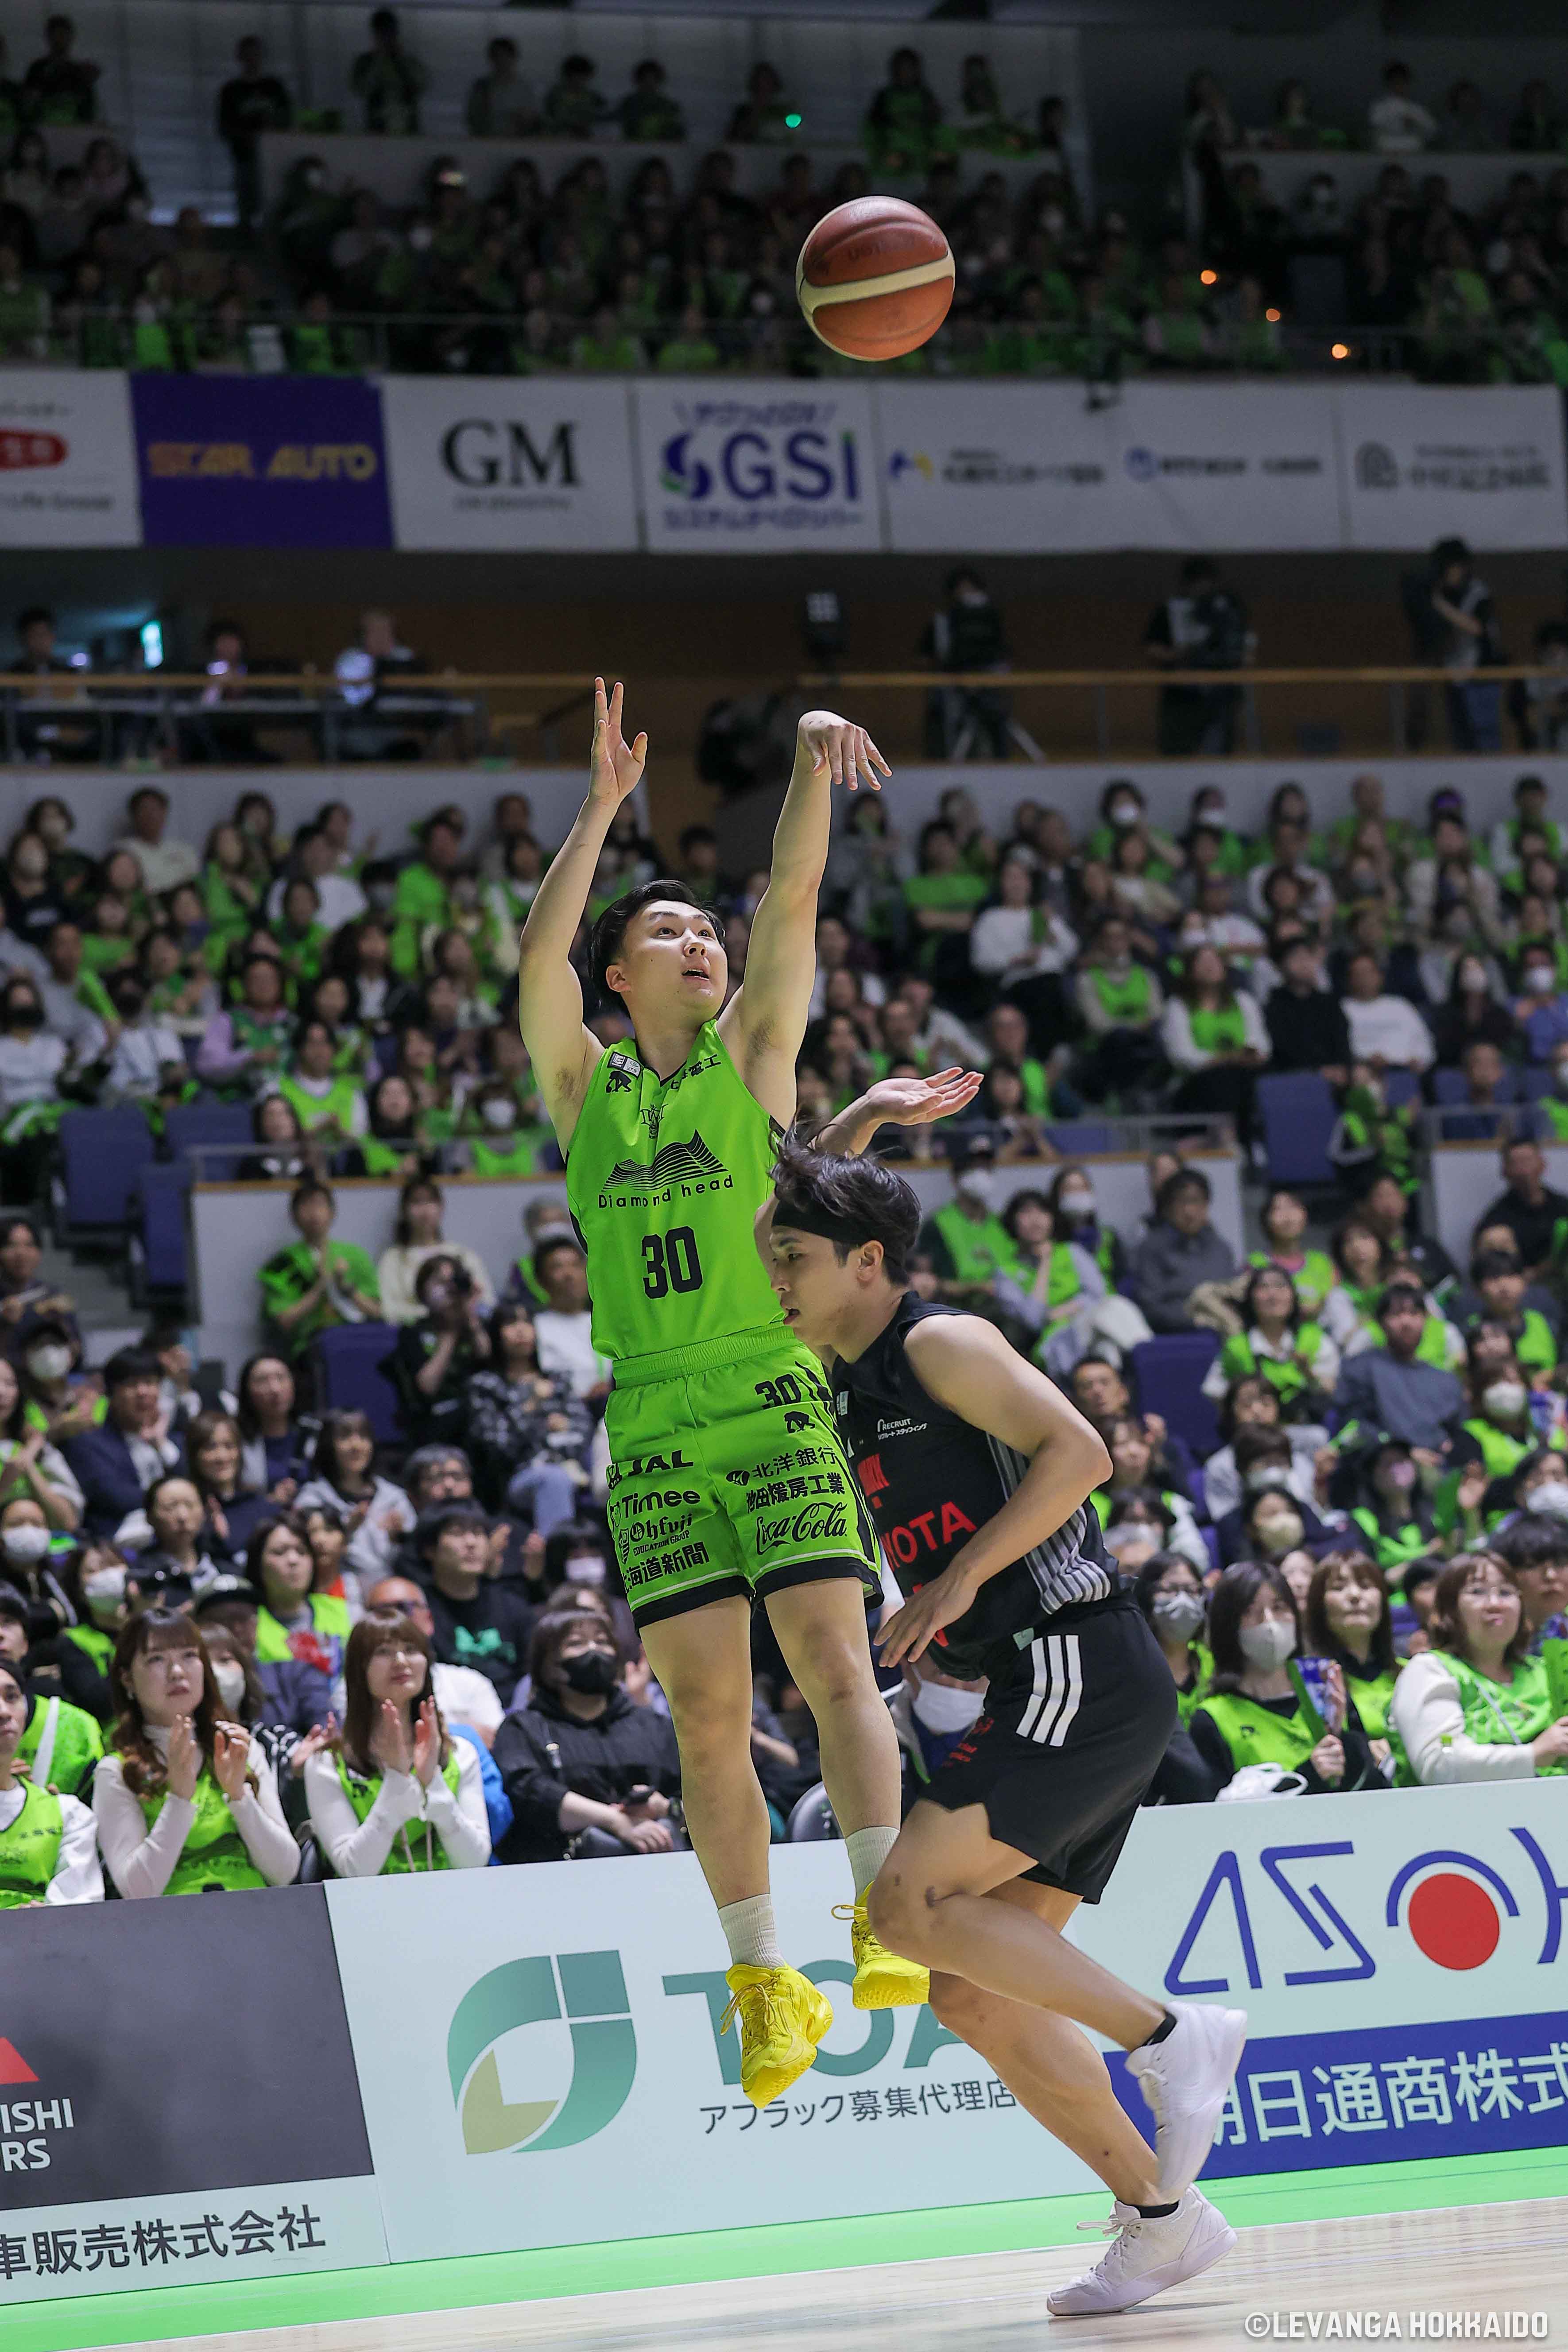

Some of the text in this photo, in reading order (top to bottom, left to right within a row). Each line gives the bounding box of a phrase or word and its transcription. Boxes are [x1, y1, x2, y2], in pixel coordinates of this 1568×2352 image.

[267, 444, 377, 480] AUTO
[442, 418, 582, 488] GM
[720, 430, 860, 502] GSI
[599, 1174, 733, 1208] Diamond head
[641, 1226, 703, 1299] 30
[754, 1374, 801, 1410] 30
[882, 1418, 911, 1431] RECRUIT
[628, 1449, 694, 1477] JAL
[751, 1446, 837, 1478] 北洋銀行
[621, 1490, 701, 1519] Timee
[630, 1513, 692, 1542] Ohfuji
[633, 1530, 690, 1557] EDUCATION GROUP
[756, 1502, 848, 1555] Coca-Cola
[700, 2080, 1017, 2134] アフラック募集代理店
[0, 2205, 325, 2280] 車販売株式会社
